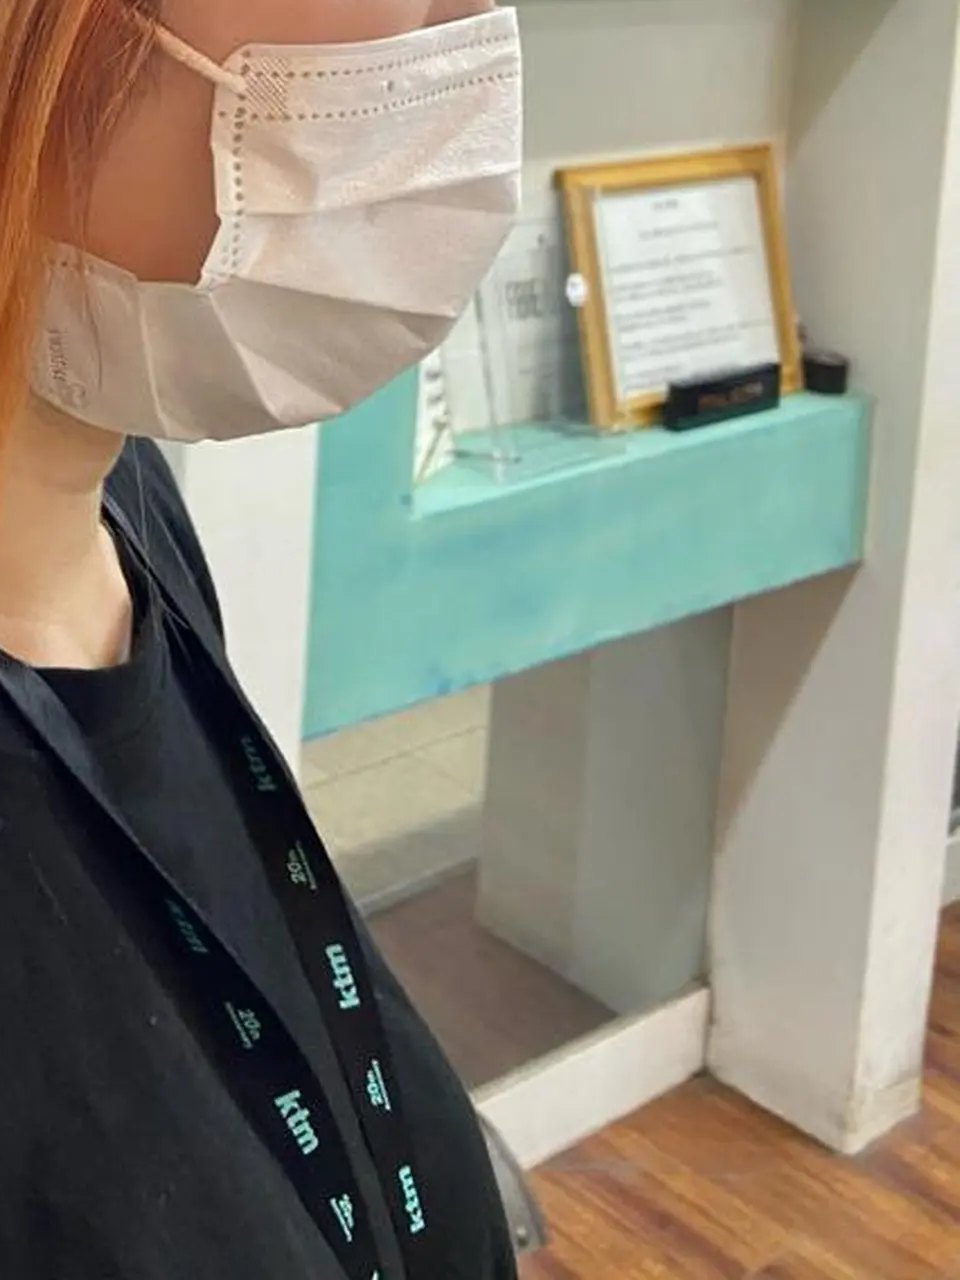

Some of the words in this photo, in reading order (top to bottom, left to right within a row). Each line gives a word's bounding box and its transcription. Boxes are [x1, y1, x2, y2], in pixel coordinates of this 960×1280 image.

[325, 942, 361, 1010] ktm
[273, 1088, 320, 1156] ktm
[397, 1165, 427, 1235] ktm
